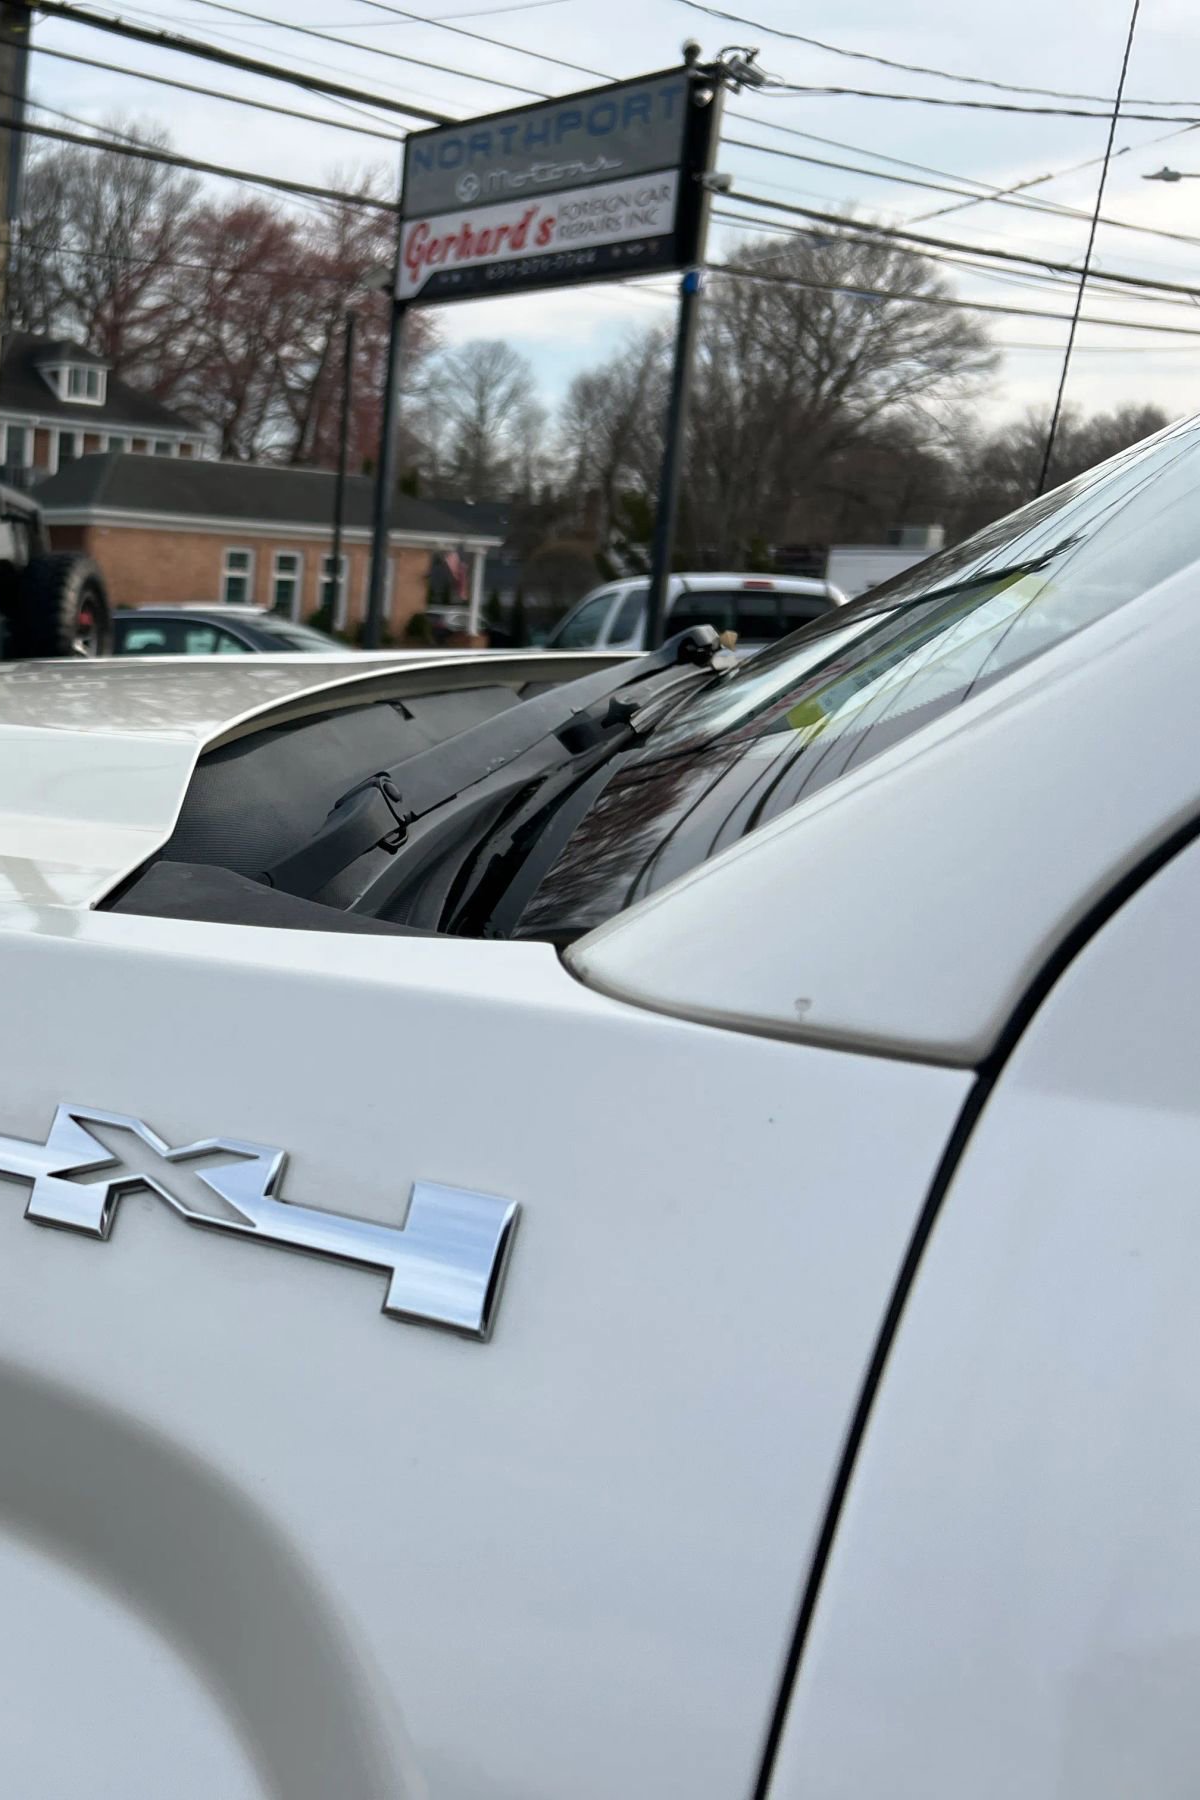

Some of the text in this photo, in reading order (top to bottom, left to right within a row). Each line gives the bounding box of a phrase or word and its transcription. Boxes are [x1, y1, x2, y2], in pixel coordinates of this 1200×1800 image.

[410, 84, 684, 173] NORTHPORT
[558, 184, 671, 220] FOREIGN CAR
[404, 204, 557, 284] Gerhard's
